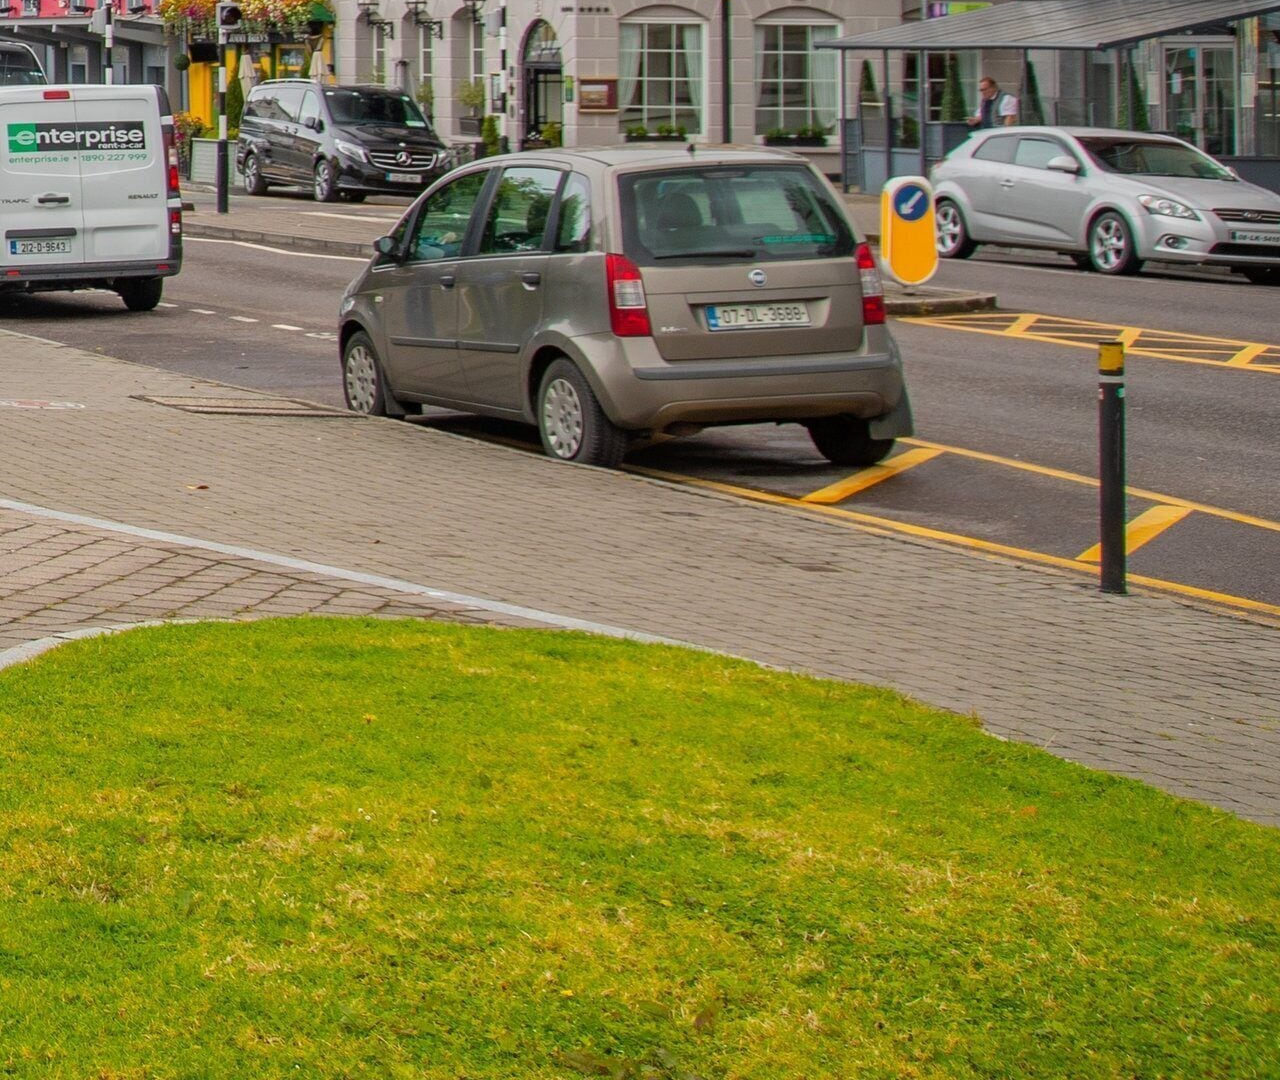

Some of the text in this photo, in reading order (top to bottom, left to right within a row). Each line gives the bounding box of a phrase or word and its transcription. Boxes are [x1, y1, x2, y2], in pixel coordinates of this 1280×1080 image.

[16, 126, 144, 148] enterprise
[9, 155, 70, 164] enterprise.ie
[81, 154, 105, 162] 1890
[128, 153, 147, 161] 999
